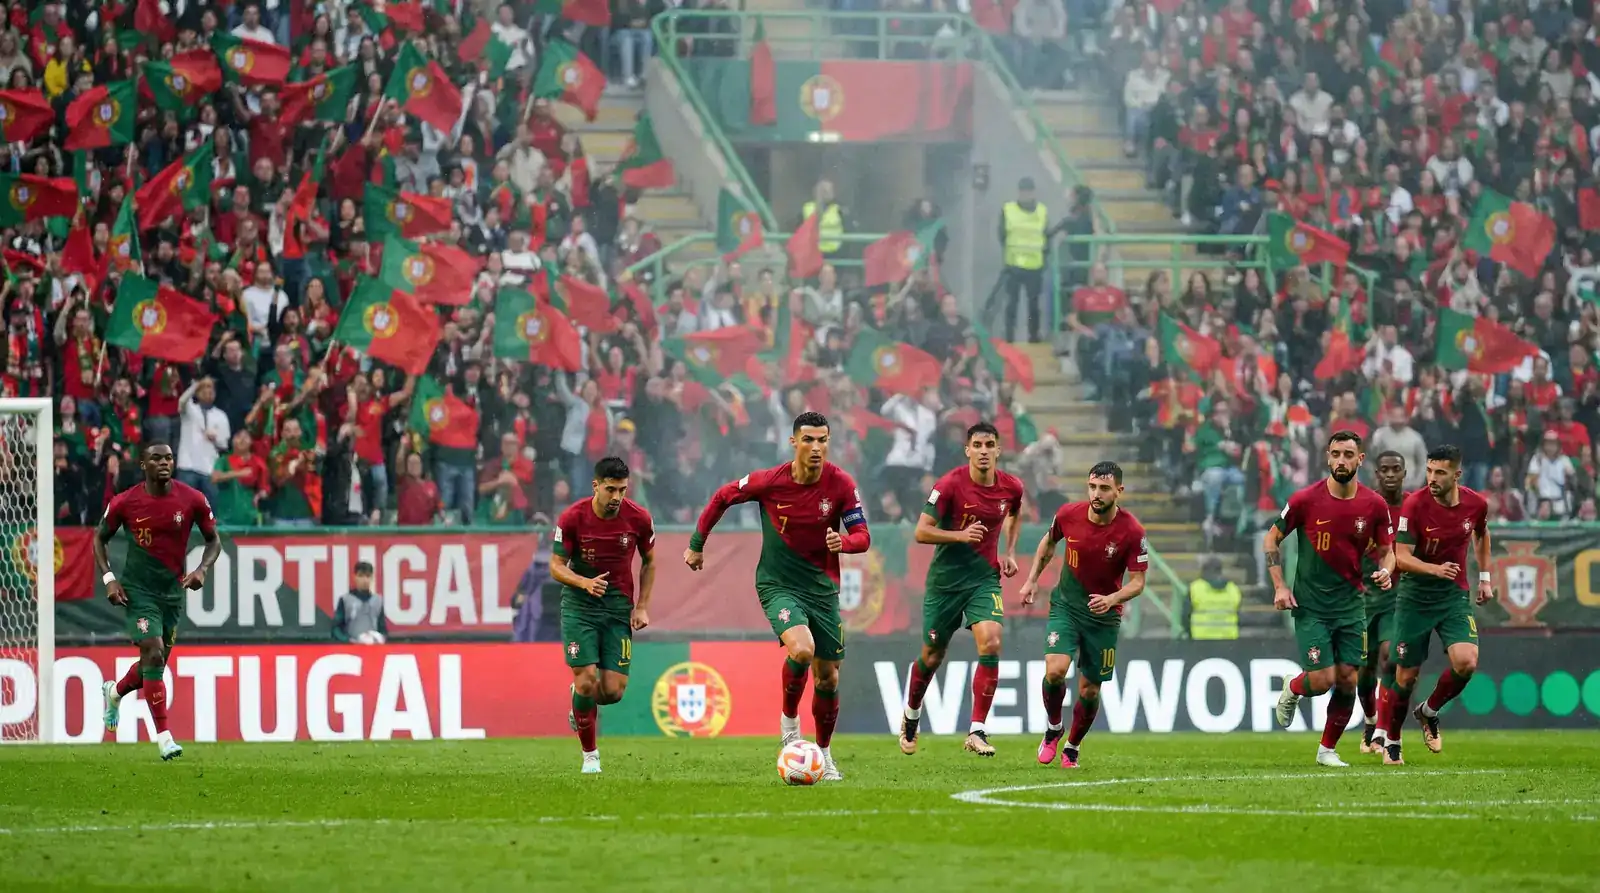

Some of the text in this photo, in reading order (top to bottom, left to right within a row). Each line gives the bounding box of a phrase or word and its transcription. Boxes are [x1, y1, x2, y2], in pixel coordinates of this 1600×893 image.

[779, 516, 787, 534] 7
[1317, 531, 1330, 551] 18
[1425, 537, 1439, 555] 17
[1068, 548, 1078, 568] 10
[185, 544, 514, 627] ORTUGAL
[1102, 648, 1115, 668] 10
